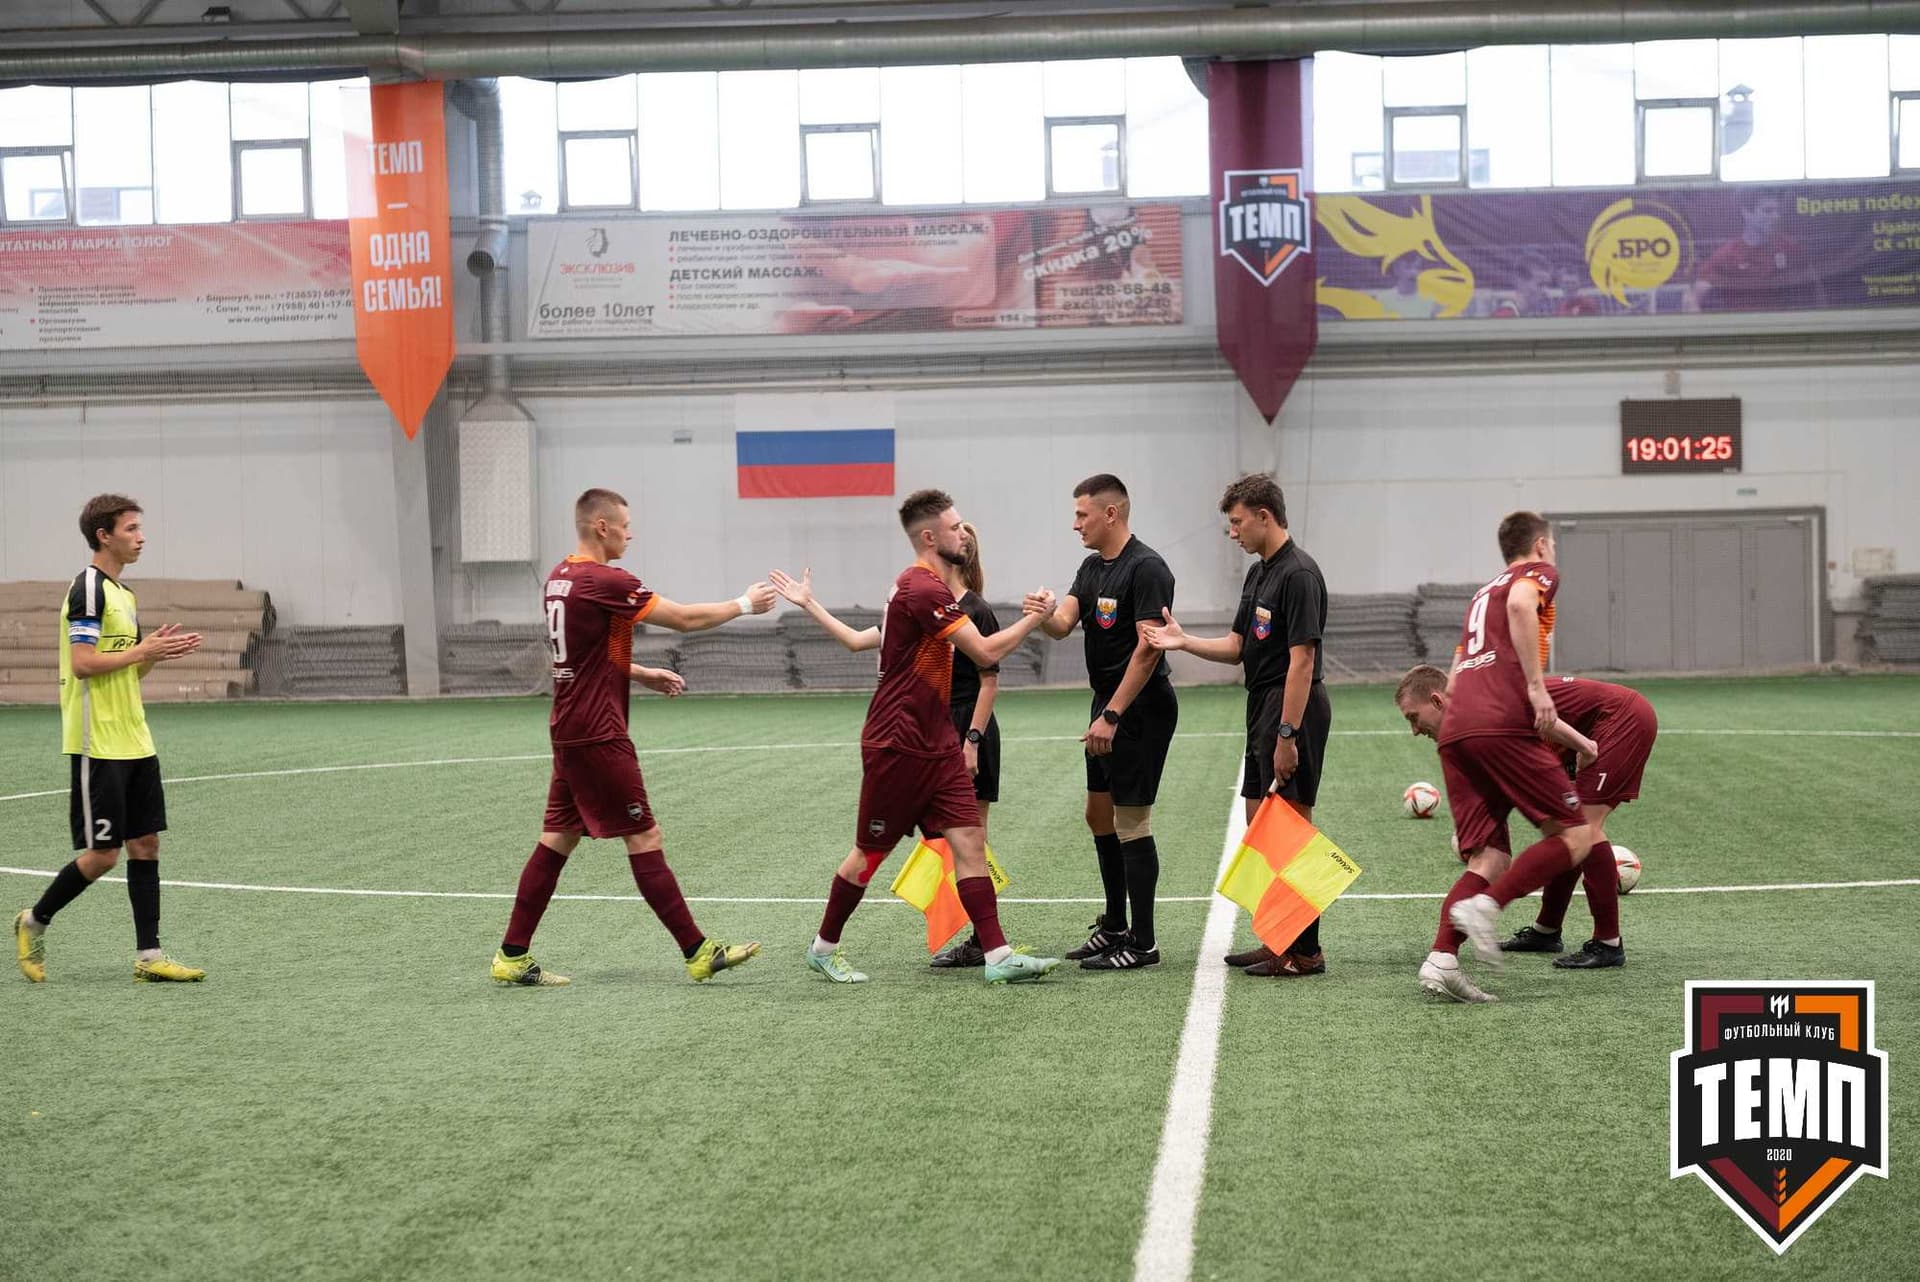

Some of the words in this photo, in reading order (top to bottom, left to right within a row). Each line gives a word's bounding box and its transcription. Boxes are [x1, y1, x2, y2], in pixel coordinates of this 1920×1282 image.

[367, 140, 423, 175] ТЕМП
[1796, 196, 1859, 216] Время
[669, 226, 909, 242] ЛЕЧЕБНО-ОЗДОРОВИТЕЛЬНЫЙ
[913, 223, 989, 236] МАССАЖ:
[1229, 202, 1301, 242] ТЕМП
[369, 230, 431, 271] ОДНА
[1024, 247, 1100, 281] скидка
[1104, 225, 1153, 254] 20%
[560, 262, 636, 275] ЭКСКЛЮЗИВ
[669, 266, 743, 281] ДЕТСКИЙ
[748, 267, 824, 279] МАССАЖ:
[363, 276, 442, 313] СЕМЬЯ!
[539, 303, 597, 319] более
[603, 302, 655, 318] 10лет
[1627, 436, 1733, 462] 19:01:25
[1468, 592, 1490, 655] 9
[1596, 773, 1607, 791] 7
[94, 818, 112, 841] 2
